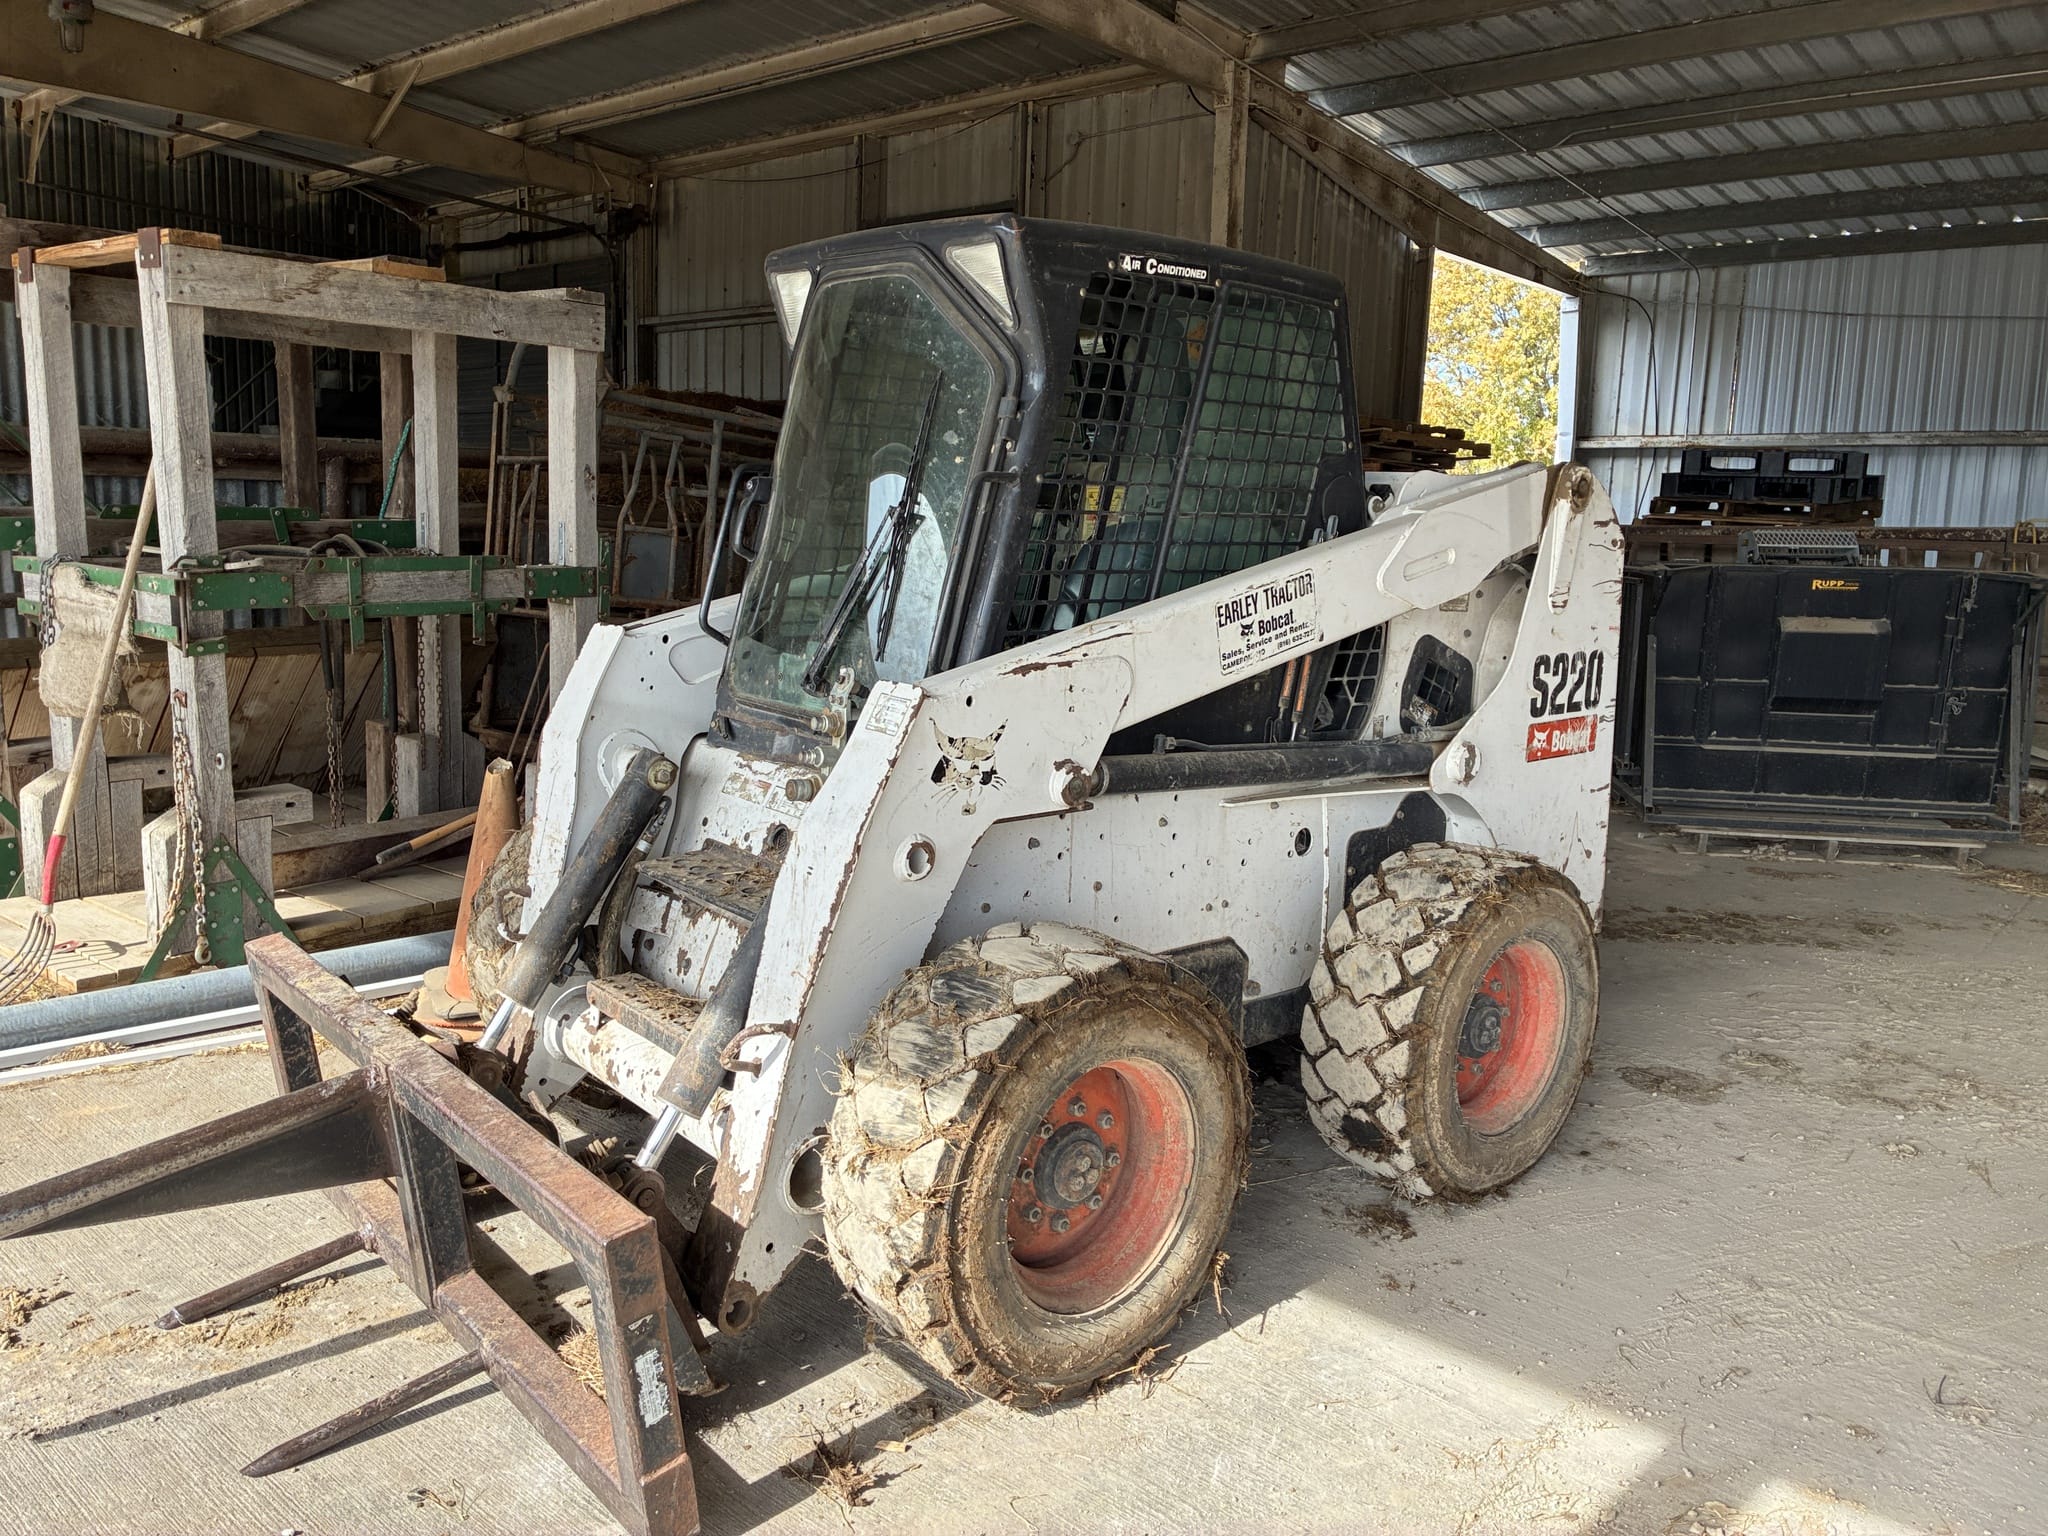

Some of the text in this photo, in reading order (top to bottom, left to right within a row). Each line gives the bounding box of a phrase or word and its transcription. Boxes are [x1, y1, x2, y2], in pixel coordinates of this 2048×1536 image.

[1146, 258, 1207, 280] CONDITIONED
[1812, 579, 1845, 590] RUPP
[1217, 573, 1313, 628] EARLEY TRACTOR
[1258, 608, 1295, 637] Bobcat
[1222, 648, 1245, 661] Sales,
[1246, 637, 1273, 652] Service
[1274, 629, 1288, 640] and
[1530, 649, 1604, 718] S220
